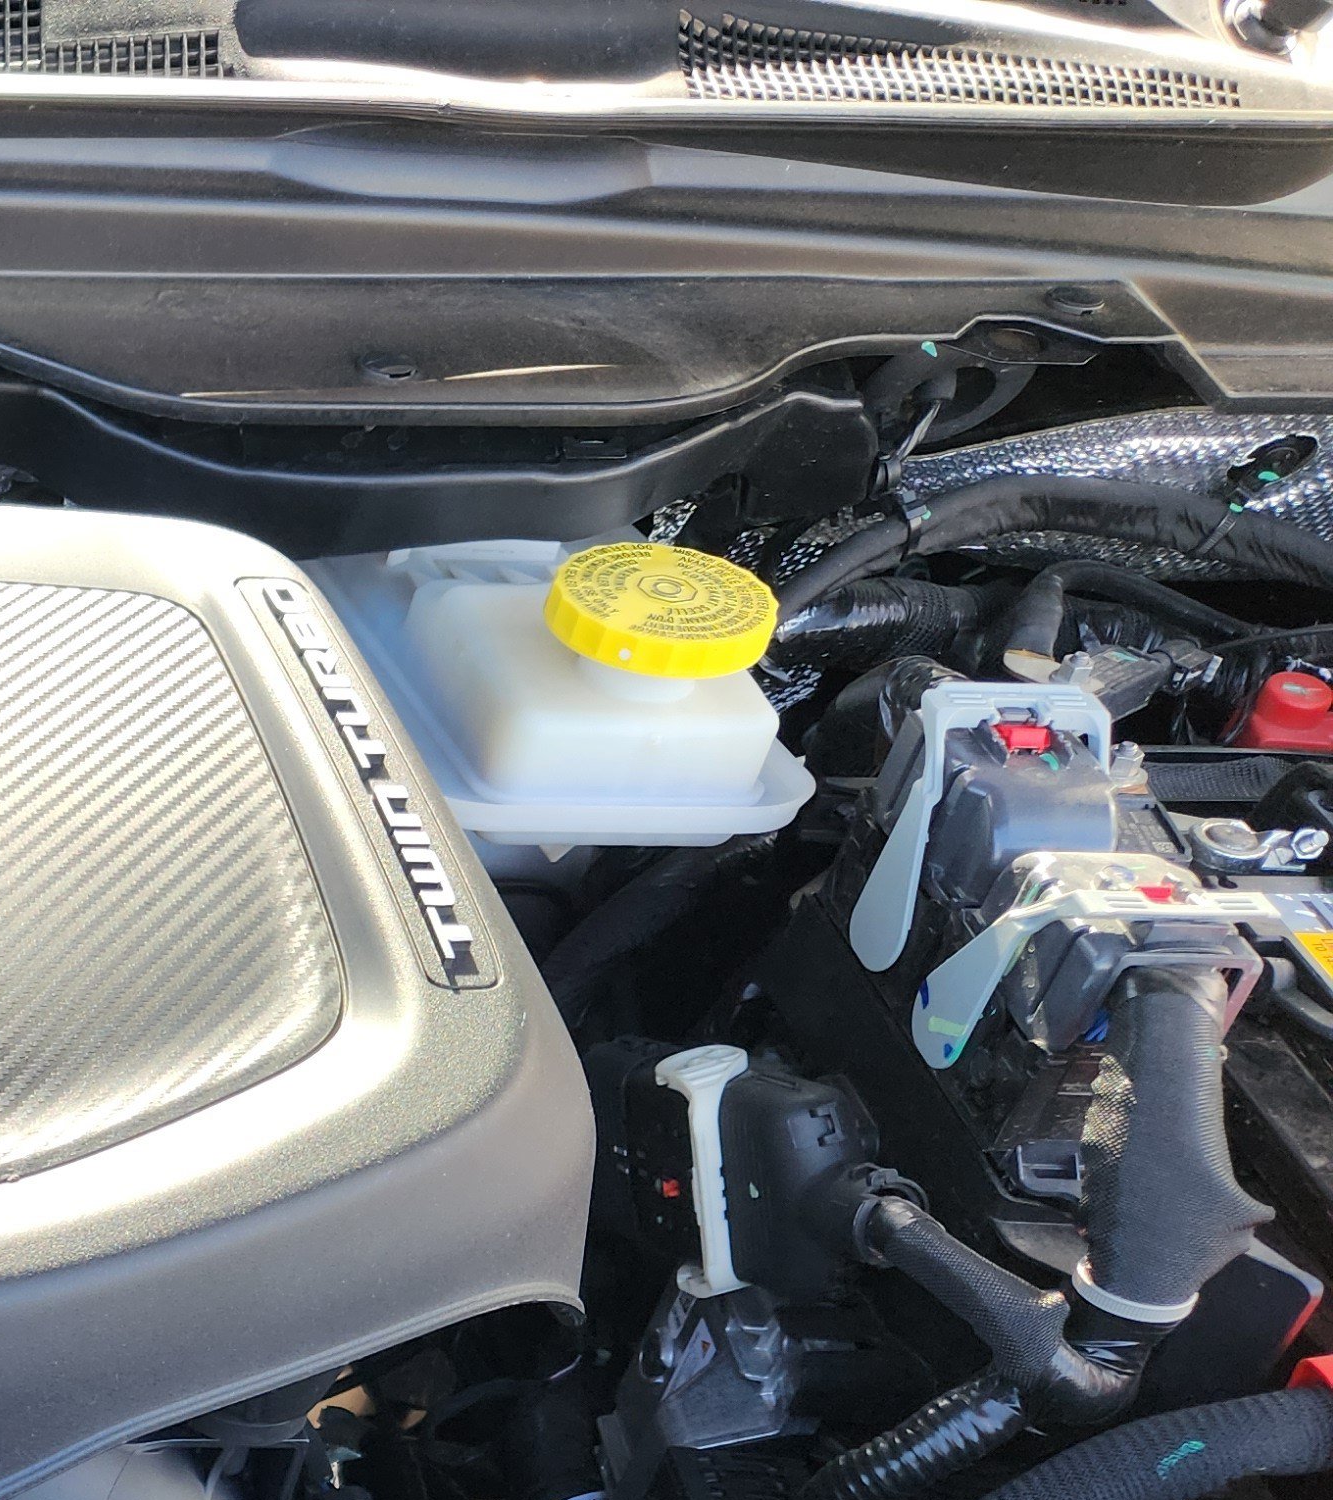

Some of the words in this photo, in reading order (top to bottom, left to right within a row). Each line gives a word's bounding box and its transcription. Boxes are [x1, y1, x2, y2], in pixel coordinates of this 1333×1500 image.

[673, 549, 699, 558] MISE
[679, 557, 715, 570] AVANT
[263, 583, 385, 772] TURBO
[375, 785, 474, 964] TWIN
